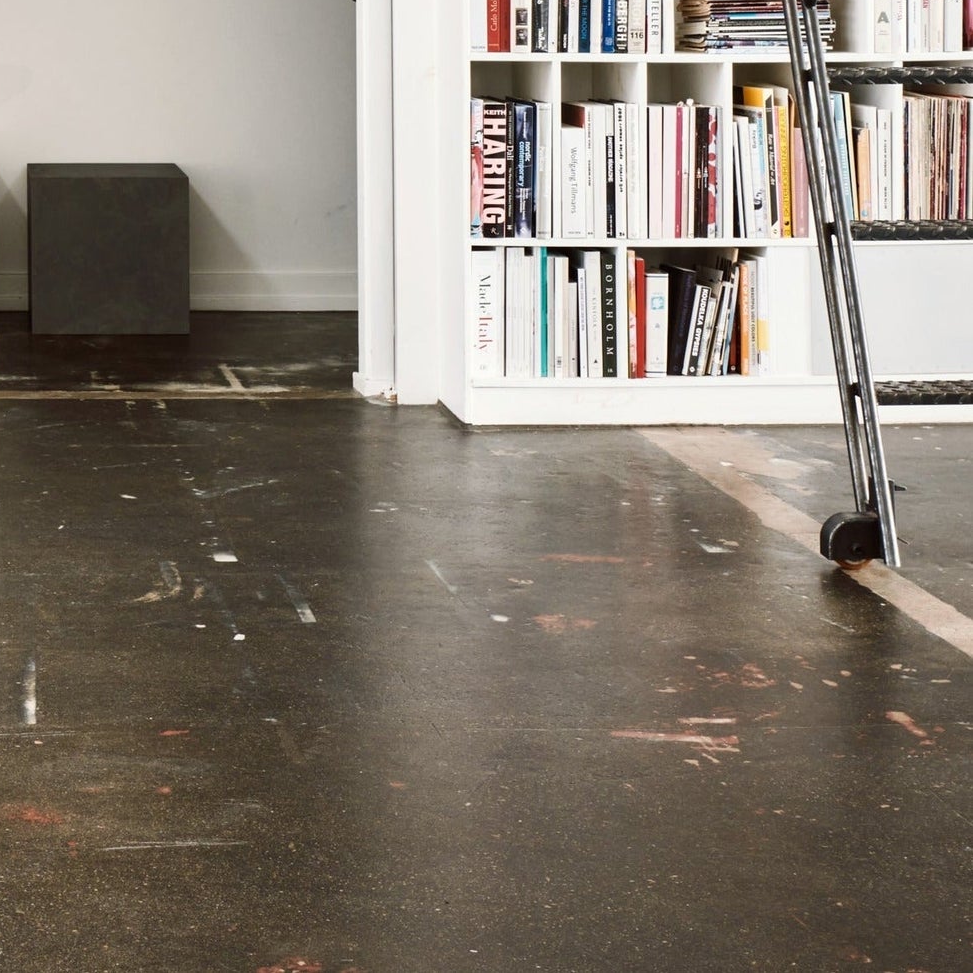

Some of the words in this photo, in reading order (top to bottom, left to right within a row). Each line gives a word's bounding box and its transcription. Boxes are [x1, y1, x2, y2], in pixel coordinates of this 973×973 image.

[483, 118, 506, 224] HARING
[518, 141, 526, 187] contemporary
[569, 147, 578, 182] Wolfgang
[479, 275, 492, 314] Made
[606, 264, 614, 355] BORNHOLM
[697, 288, 709, 326] KOUDELKA
[474, 316, 494, 350] Italy
[692, 328, 702, 357] GYPSIES
